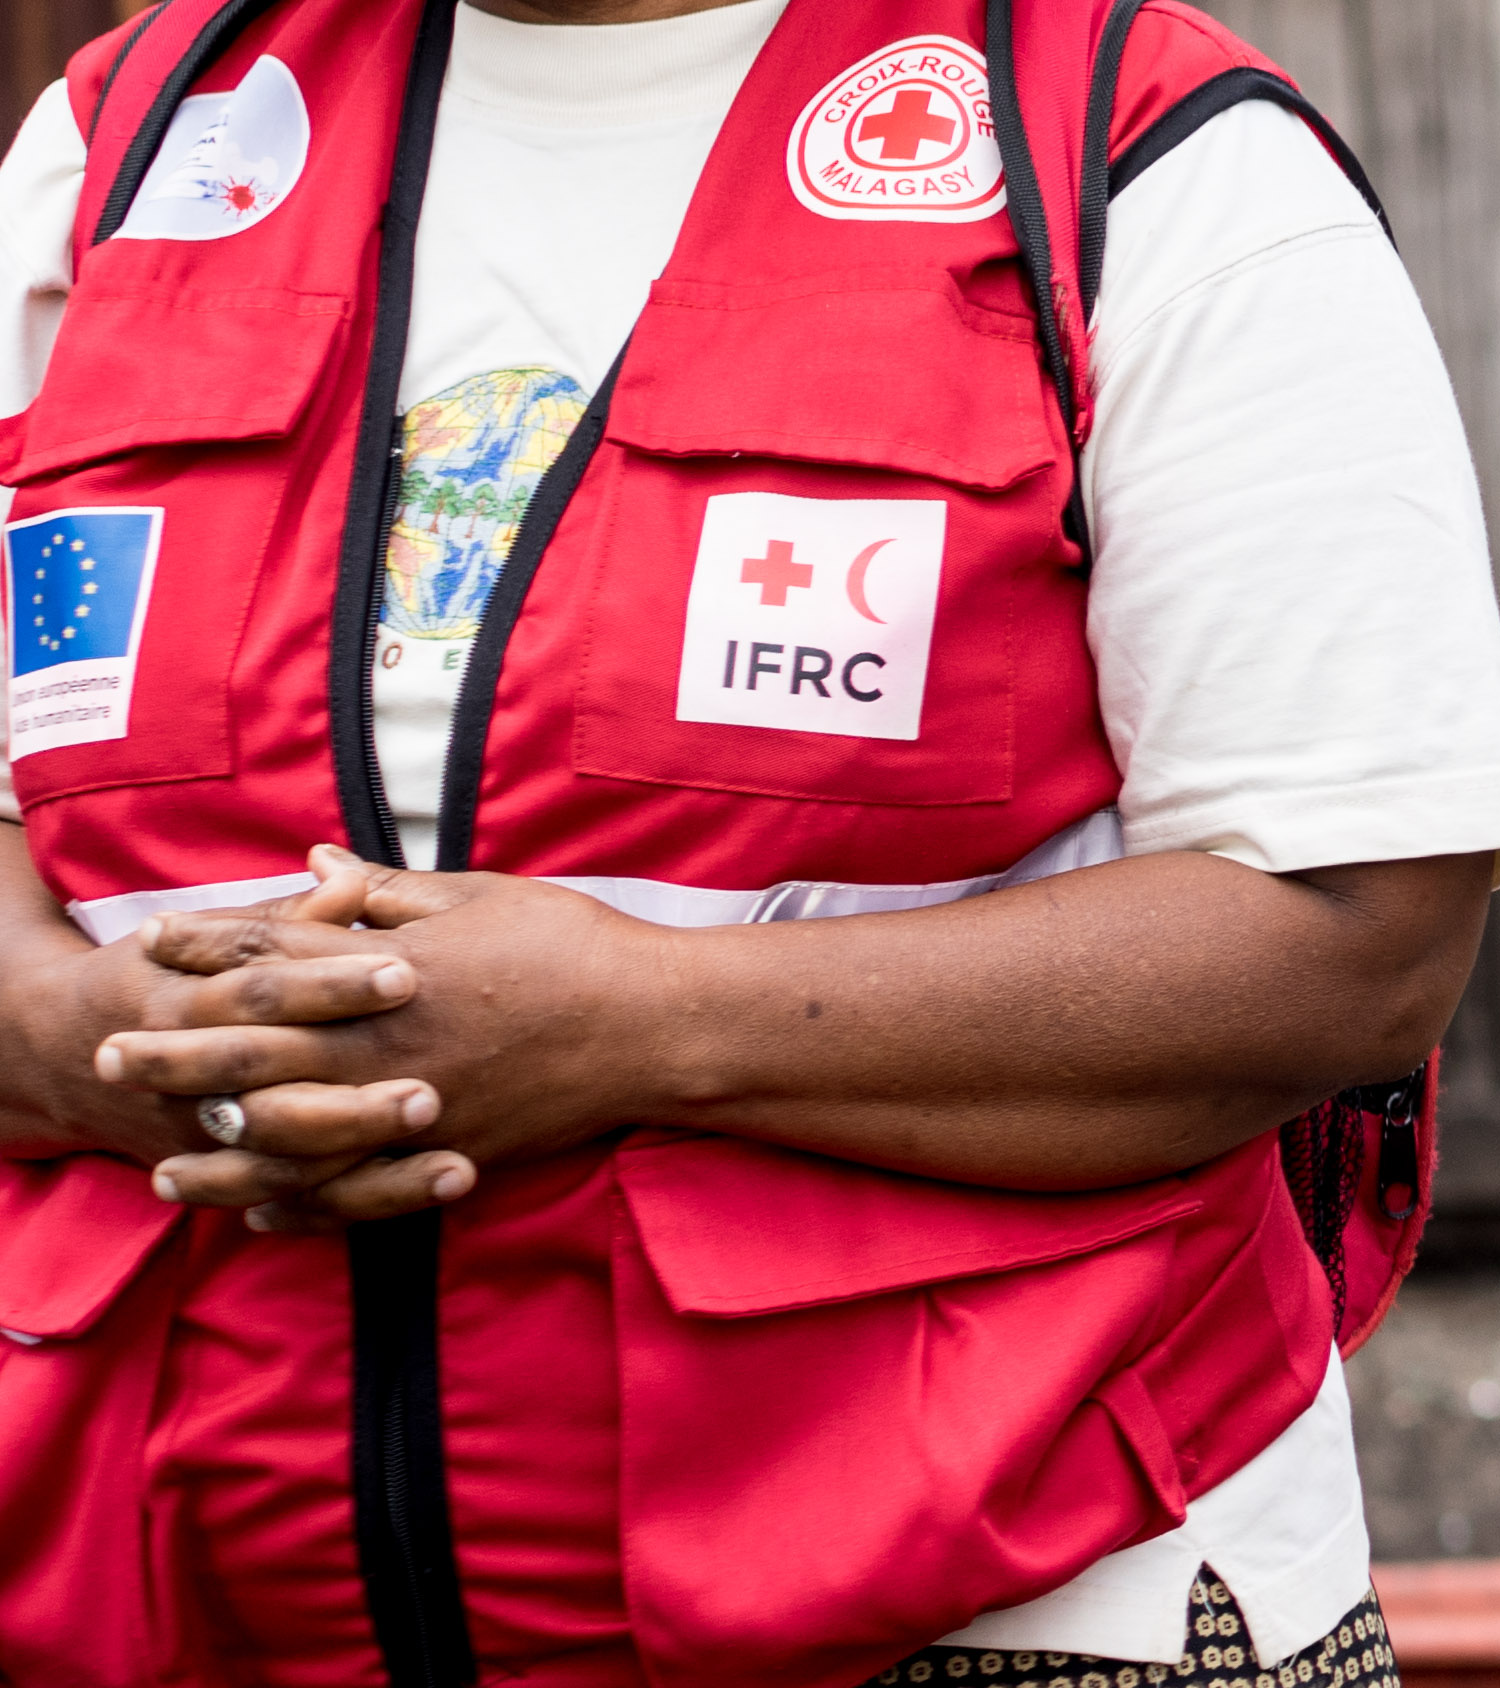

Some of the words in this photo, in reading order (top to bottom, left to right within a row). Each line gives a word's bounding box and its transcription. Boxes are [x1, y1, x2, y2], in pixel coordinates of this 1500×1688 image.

[823, 55, 997, 139] CROIX-ROUGE
[819, 159, 975, 197] MALAGASY
[722, 640, 888, 703] IFRC
